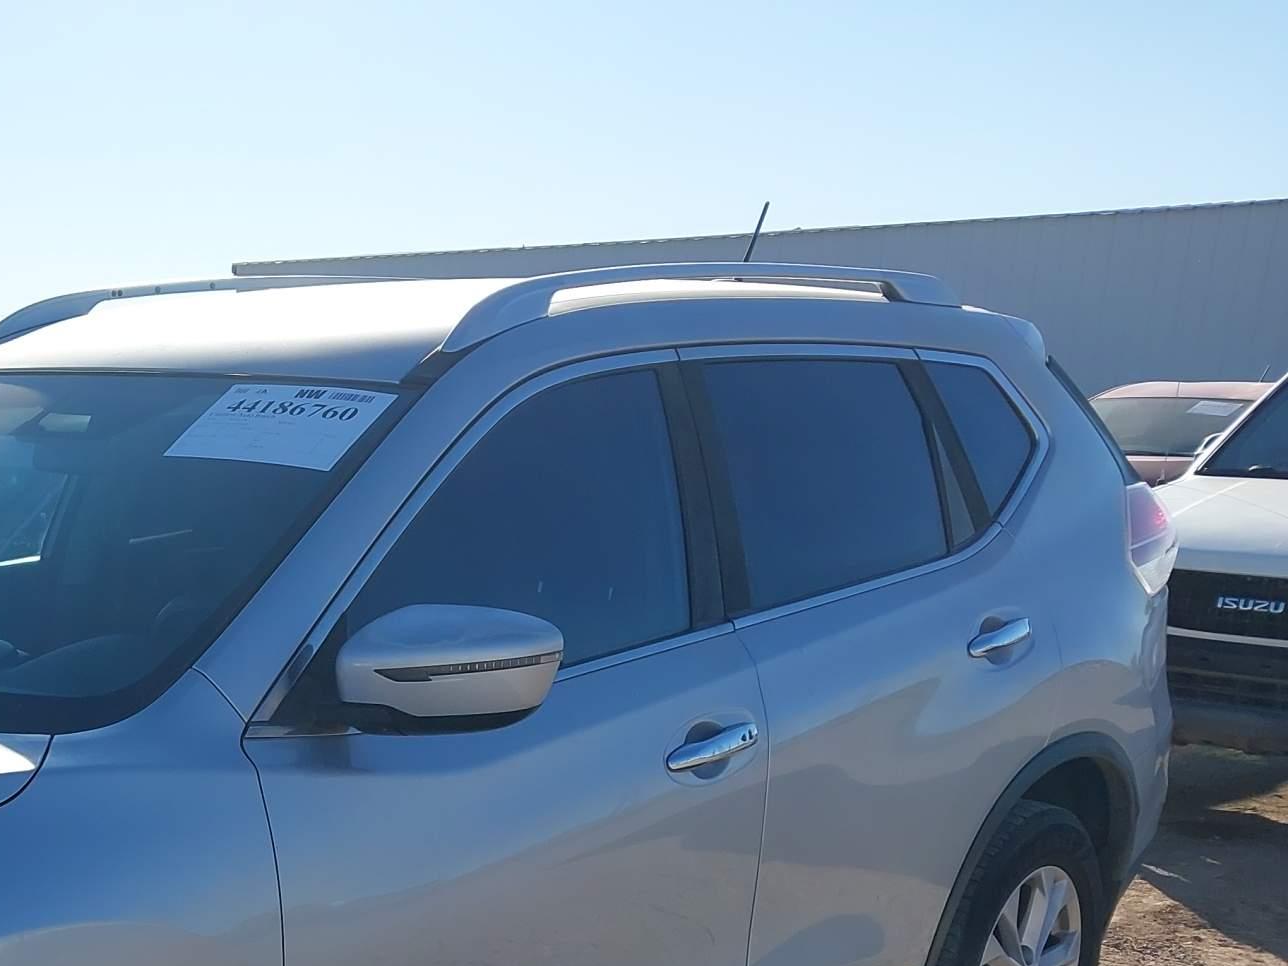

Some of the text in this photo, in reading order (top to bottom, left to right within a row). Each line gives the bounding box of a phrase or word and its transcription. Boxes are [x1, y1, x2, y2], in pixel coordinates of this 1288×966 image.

[294, 388, 328, 400] NW
[226, 398, 359, 421] 44186760
[1217, 597, 1285, 613] ISUZU
